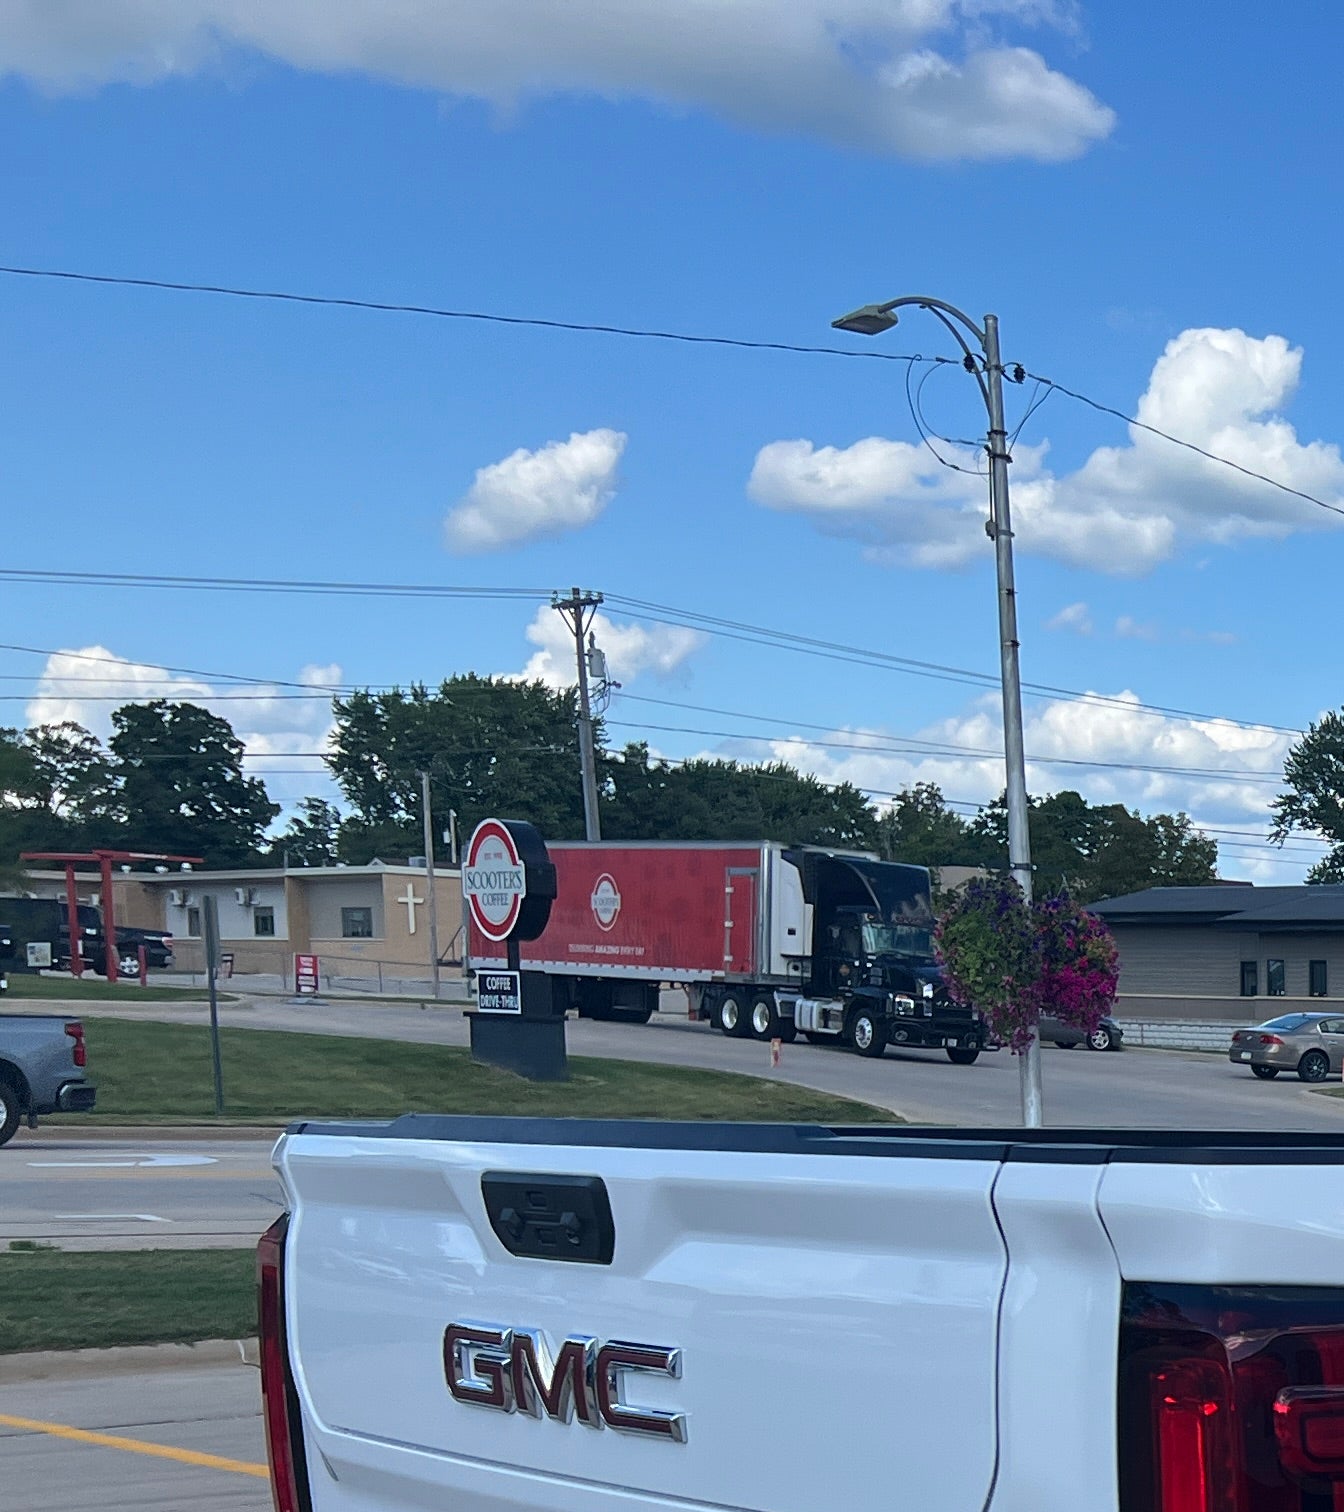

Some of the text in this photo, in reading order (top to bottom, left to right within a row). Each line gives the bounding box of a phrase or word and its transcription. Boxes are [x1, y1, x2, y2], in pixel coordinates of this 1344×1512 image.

[467, 870, 522, 890] SCOOTER'S
[481, 892, 510, 907] COFFEE
[486, 976, 511, 991] COFFEE
[480, 994, 519, 1009] DRIVE-THRU
[443, 1318, 688, 1444] GMC
